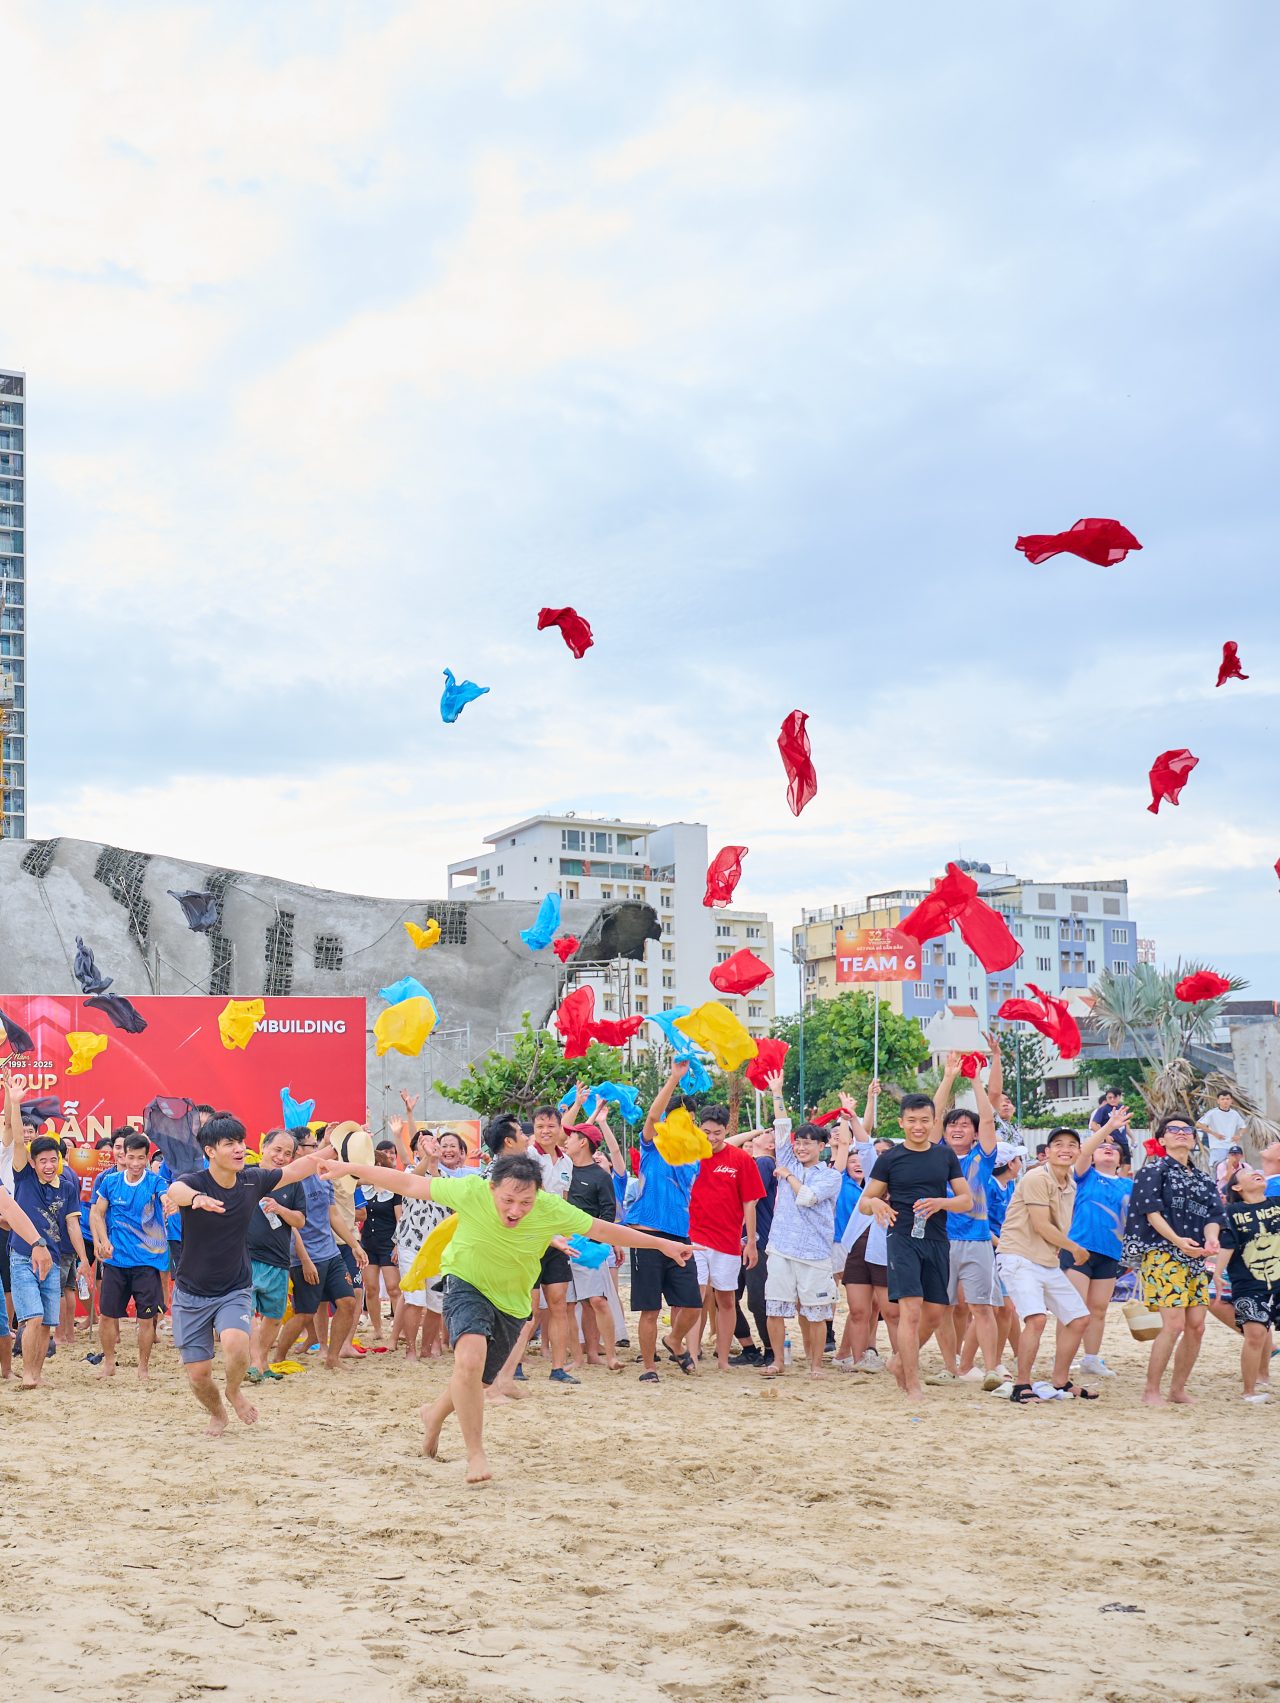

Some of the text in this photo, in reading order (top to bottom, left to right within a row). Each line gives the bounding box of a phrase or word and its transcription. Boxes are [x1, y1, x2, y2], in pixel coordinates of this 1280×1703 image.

[840, 955, 916, 972] TEAM 6
[253, 1019, 346, 1034] MBUILDING
[9, 1060, 26, 1068] 1993
[33, 1060, 53, 1068] 2025
